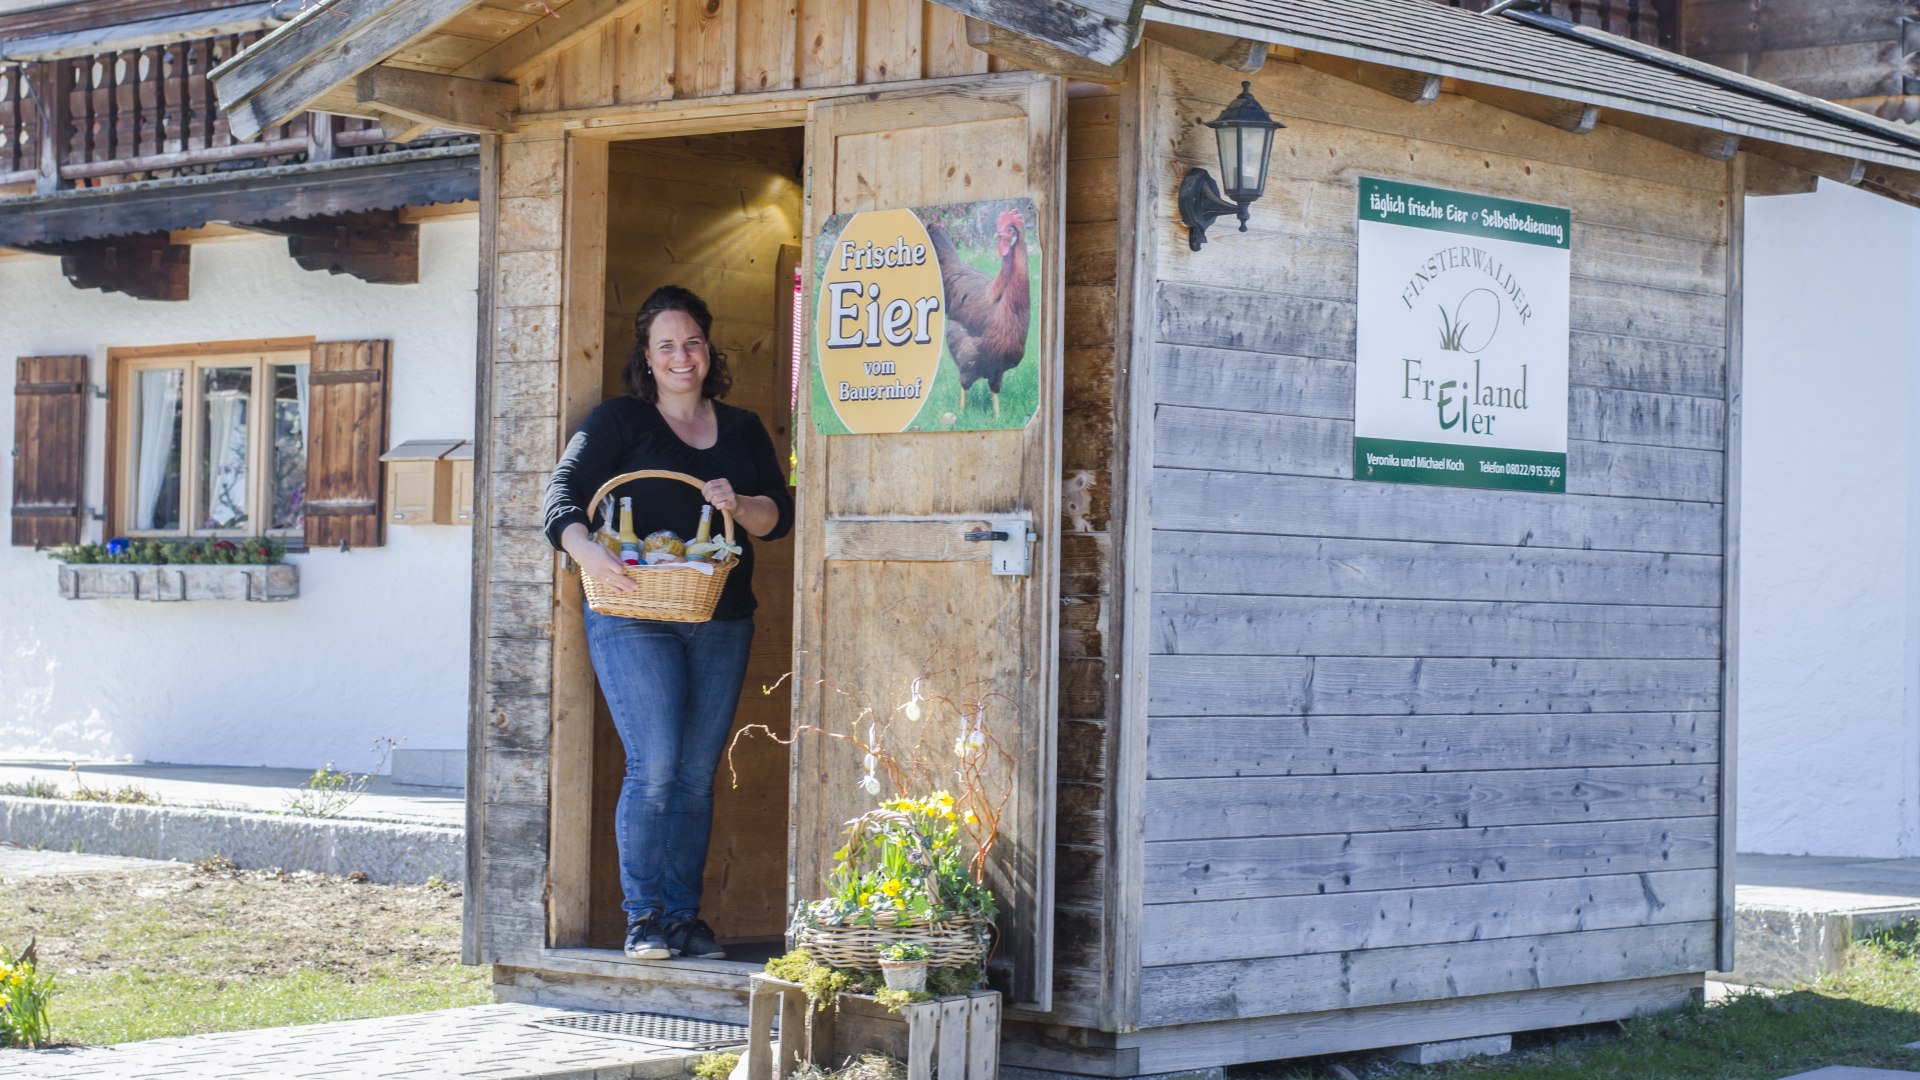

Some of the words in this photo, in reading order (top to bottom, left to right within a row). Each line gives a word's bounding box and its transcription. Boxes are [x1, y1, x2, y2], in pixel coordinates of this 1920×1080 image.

[1370, 193, 1405, 218] täglich
[1408, 197, 1444, 219] frische
[1446, 204, 1469, 223] Eier
[1480, 208, 1564, 244] Selbstbedienung
[840, 235, 926, 271] Frische
[1401, 246, 1532, 326] FINSTERWALDER
[826, 280, 940, 349] Eier
[864, 360, 896, 376] vom
[839, 378, 922, 401] Bauernhof
[1366, 452, 1399, 467] Veronika
[1401, 456, 1415, 467] und
[1417, 456, 1445, 470] Michael
[1446, 458, 1465, 471] Koch
[1479, 460, 1505, 474] Telefon
[1506, 463, 1561, 478] 08022/9153566
